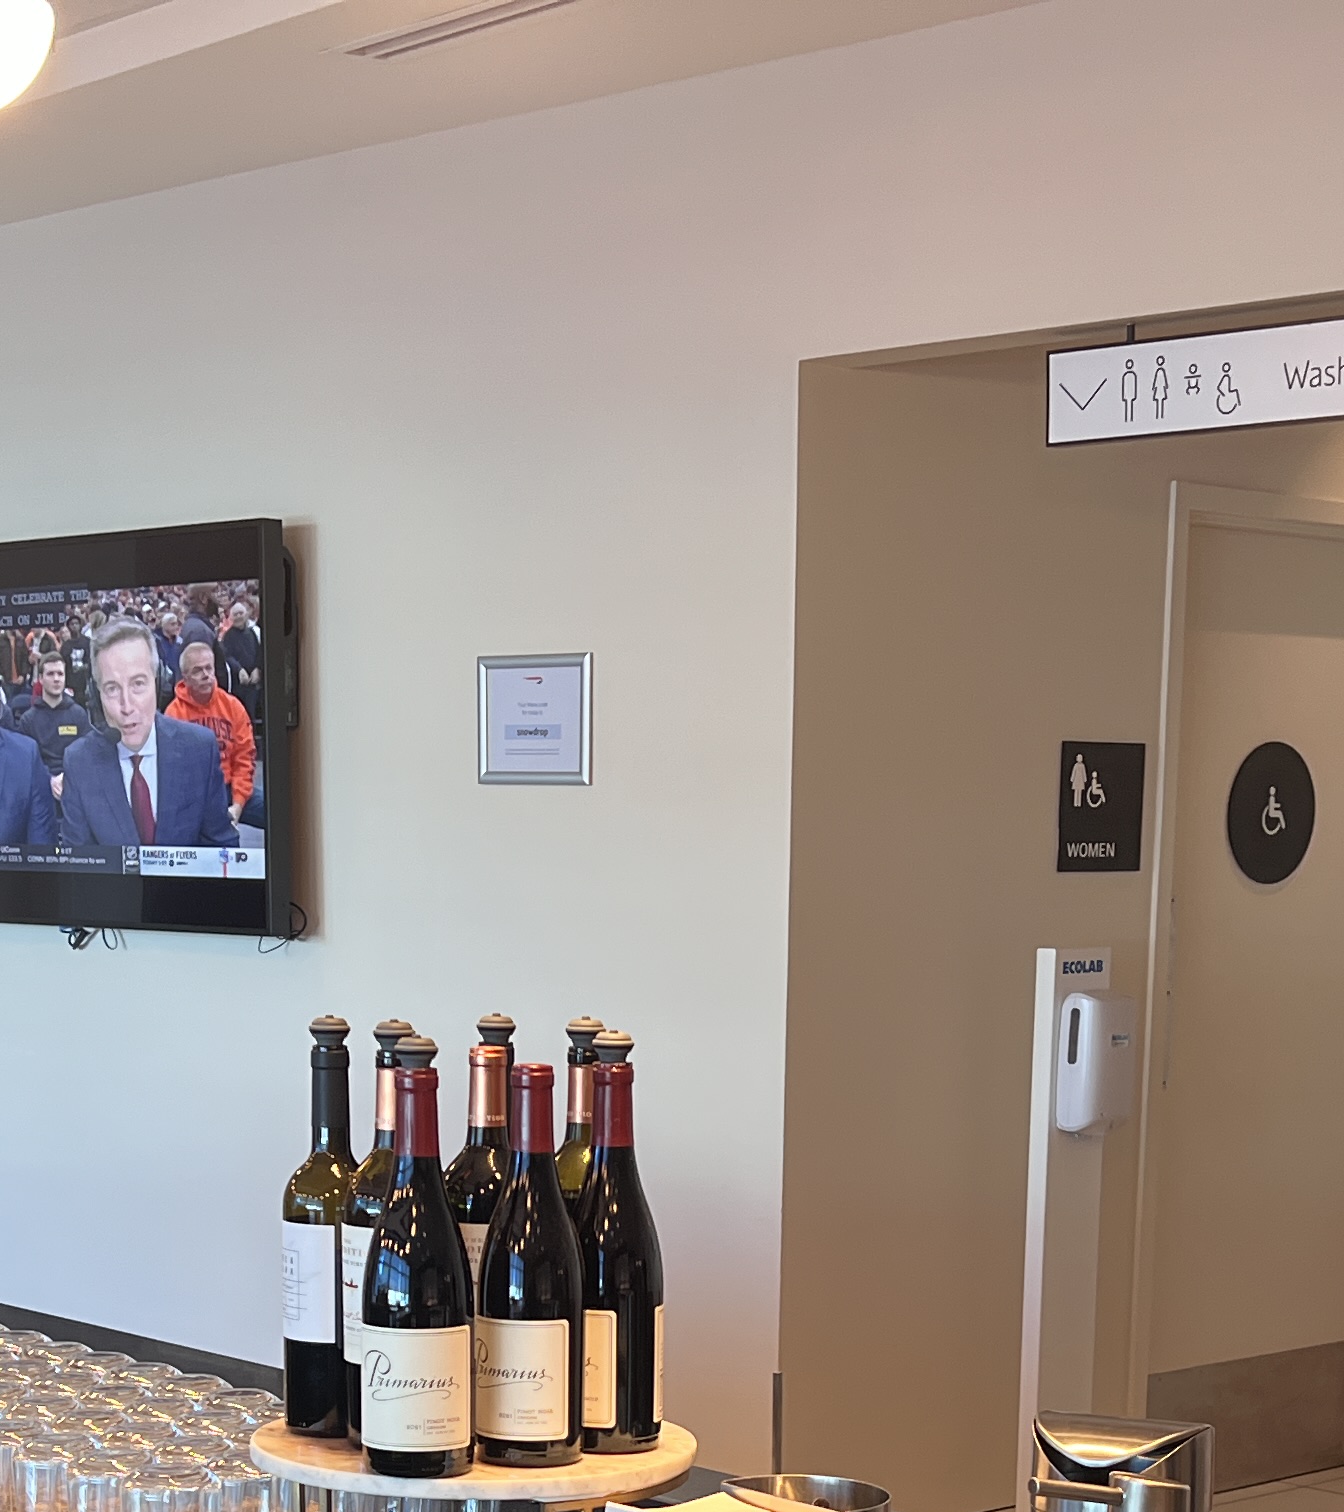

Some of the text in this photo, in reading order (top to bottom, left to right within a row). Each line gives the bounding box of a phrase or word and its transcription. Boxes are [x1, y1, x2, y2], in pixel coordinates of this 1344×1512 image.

[11, 592, 65, 605] CELEBRATE
[18, 615, 31, 626] ON
[35, 614, 54, 625] JIM
[517, 727, 549, 738] snowdrop
[143, 850, 169, 859] RANGERS
[176, 851, 198, 860] FLYERS
[1067, 843, 1116, 858] WOMEN
[1063, 960, 1104, 975] ECOLAB
[475, 1338, 553, 1381] Primarius
[364, 1350, 460, 1390] Primarius
